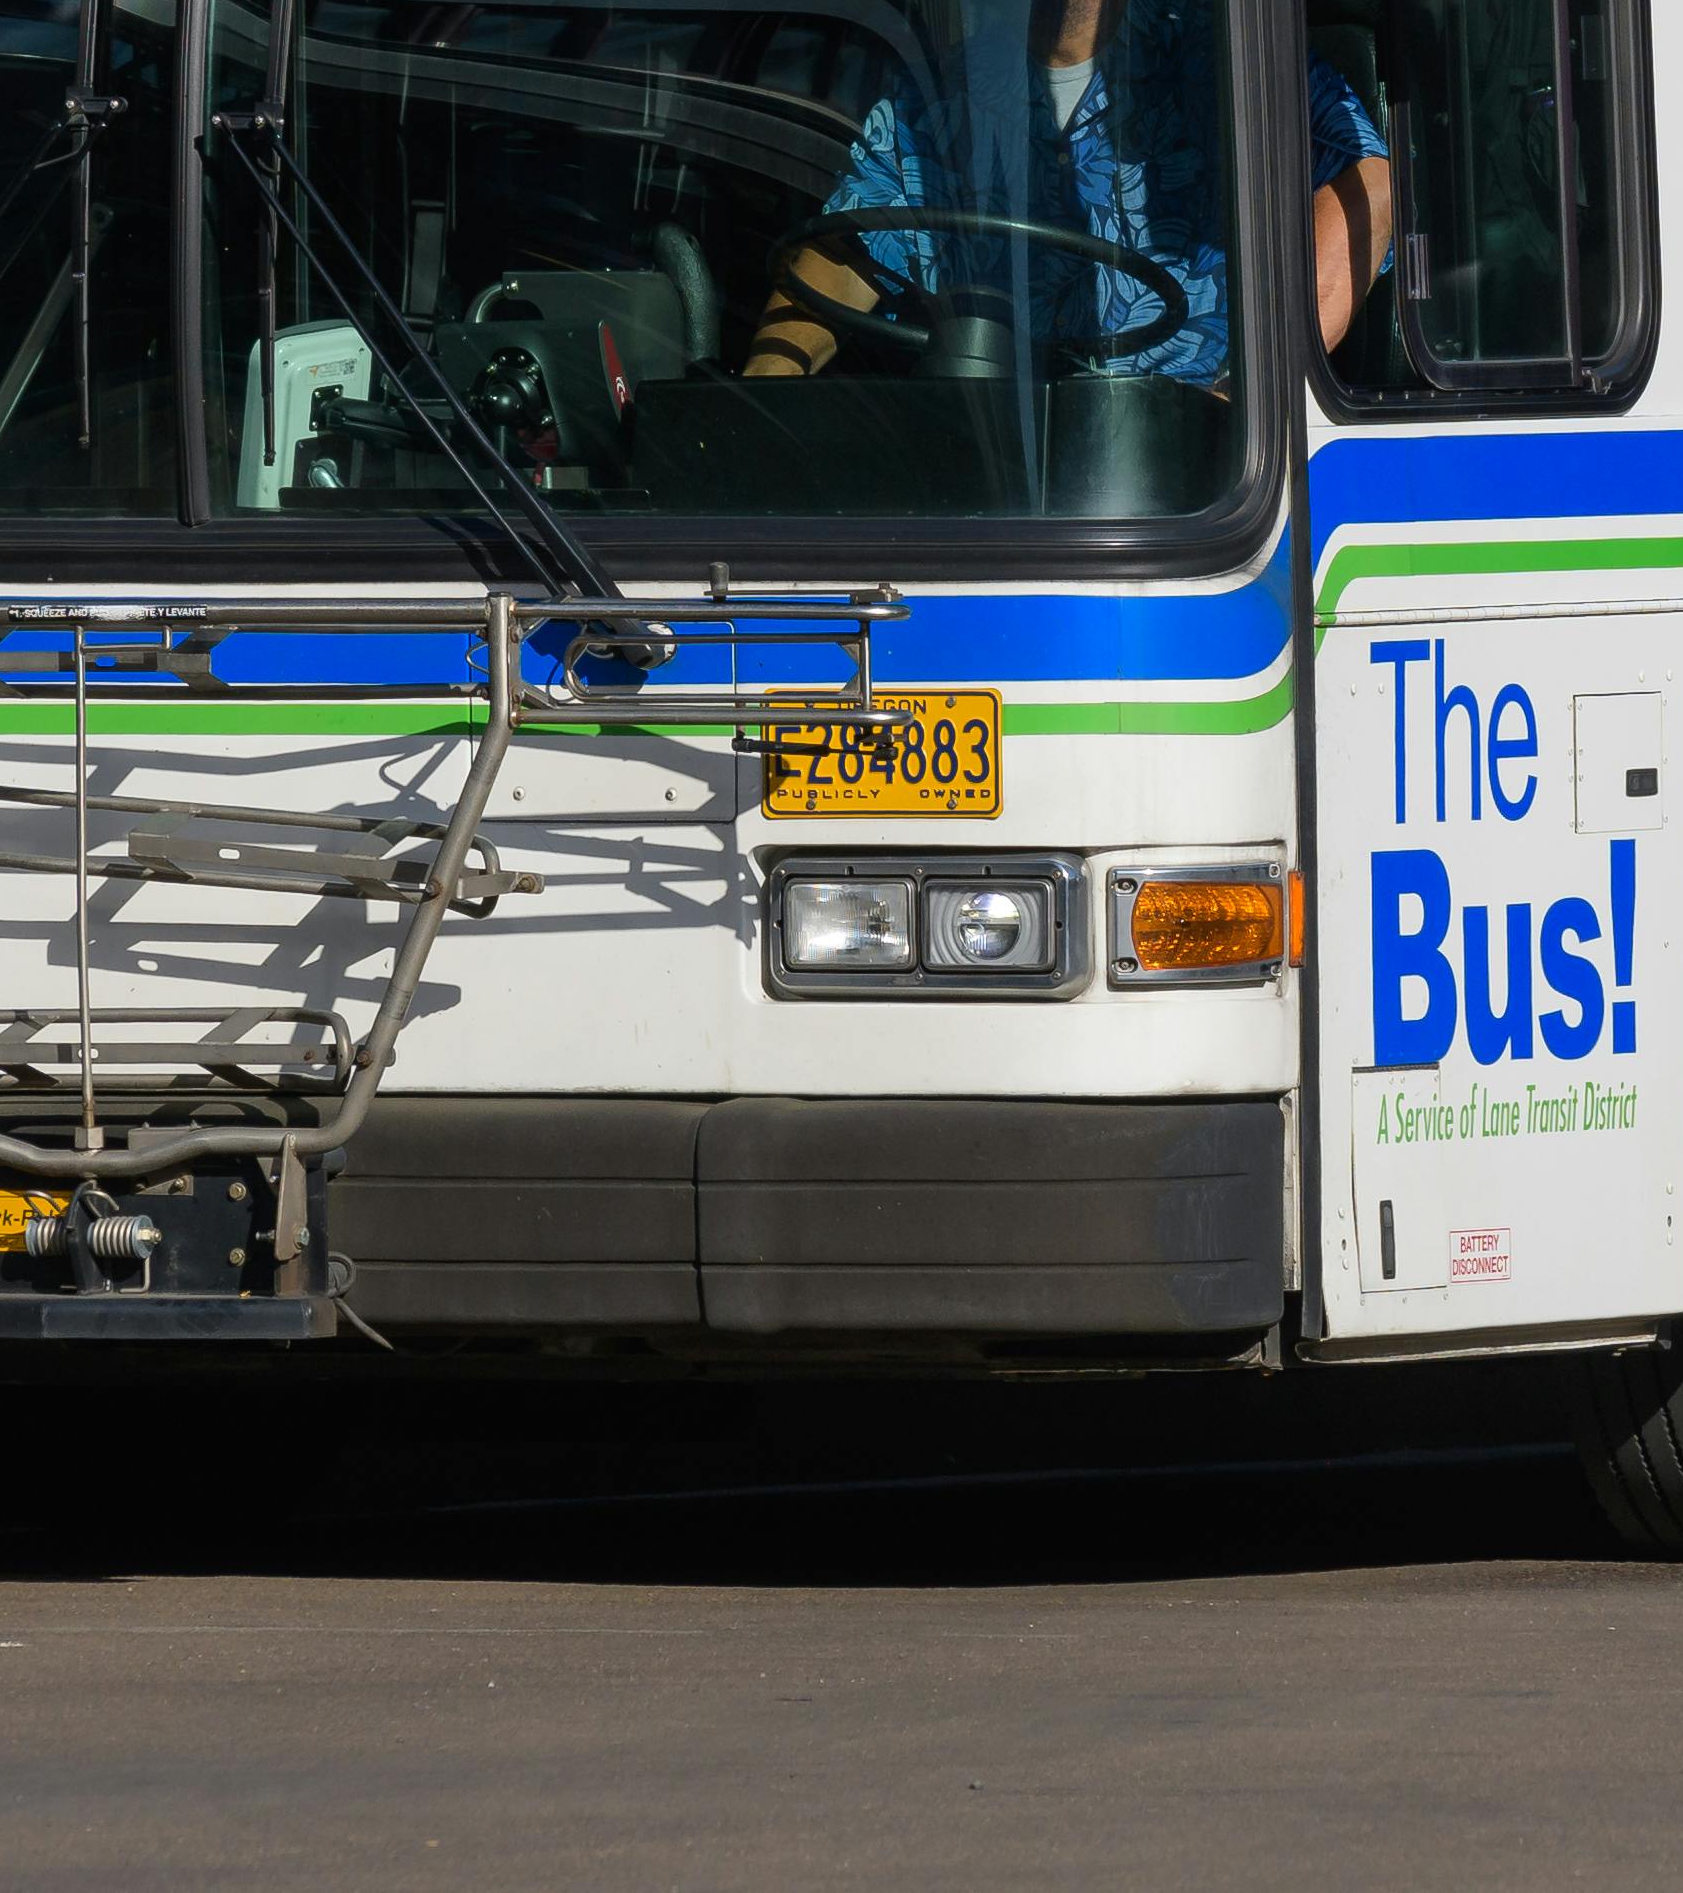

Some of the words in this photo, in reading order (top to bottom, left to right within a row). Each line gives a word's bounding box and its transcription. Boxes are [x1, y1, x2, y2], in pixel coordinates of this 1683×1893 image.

[24, 608, 67, 618] SQUEEZE
[165, 607, 207, 617] LEVANTE
[1369, 638, 1539, 825] The
[777, 789, 881, 799] PUBLICLY
[919, 789, 992, 799] OWNED
[1370, 839, 1637, 1069] Bus!
[1376, 1094, 1389, 1145] A
[1394, 1092, 1454, 1144] Service
[1459, 1082, 1478, 1140] of
[1482, 1087, 1520, 1138] Lane
[1525, 1084, 1579, 1134] Transit
[1582, 1081, 1638, 1131] District
[1460, 1234, 1500, 1254] BATTERY
[1452, 1255, 1509, 1276] DISCONNECT
